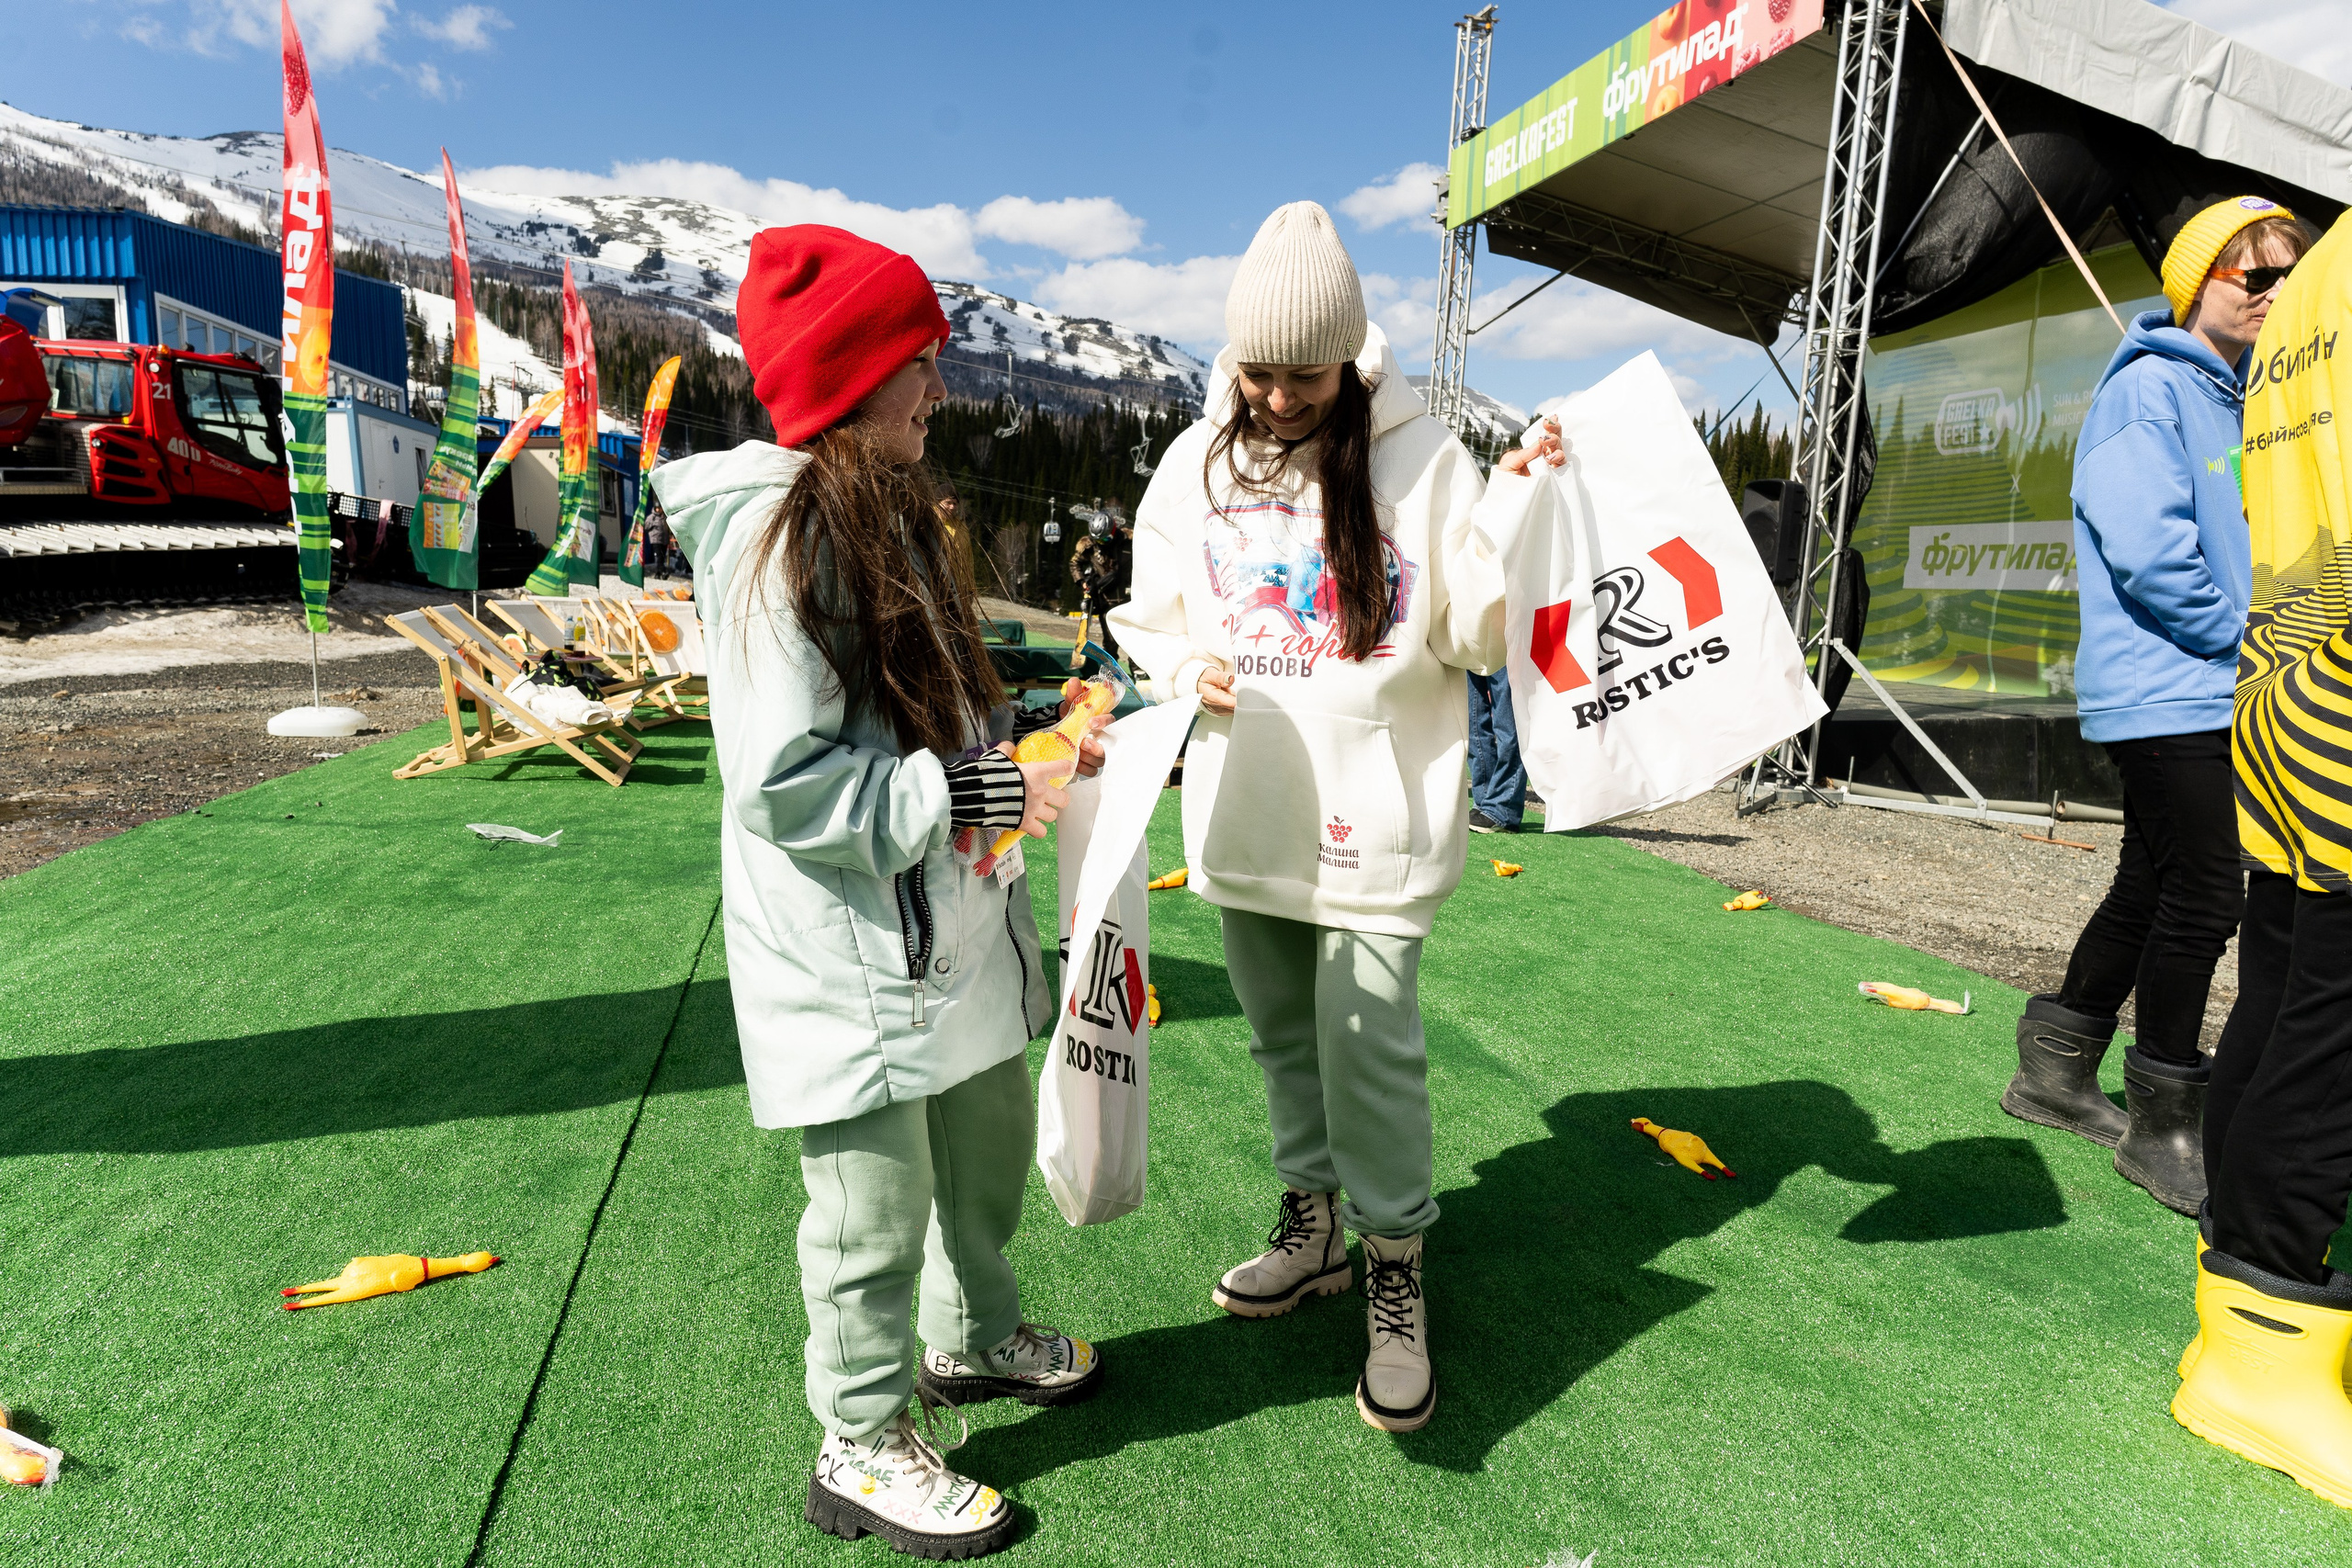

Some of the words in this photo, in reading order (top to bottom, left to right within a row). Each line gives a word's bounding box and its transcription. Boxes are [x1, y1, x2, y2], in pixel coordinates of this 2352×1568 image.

[1602, 8, 1745, 121] фрутилад
[1485, 96, 1577, 188] GRELKAFEST
[152, 382, 171, 400] 21
[2052, 392, 2072, 407] SUN
[1946, 397, 1996, 423] GRELKA
[2052, 412, 2082, 426] MUSIC
[1944, 423, 1976, 446] FEST
